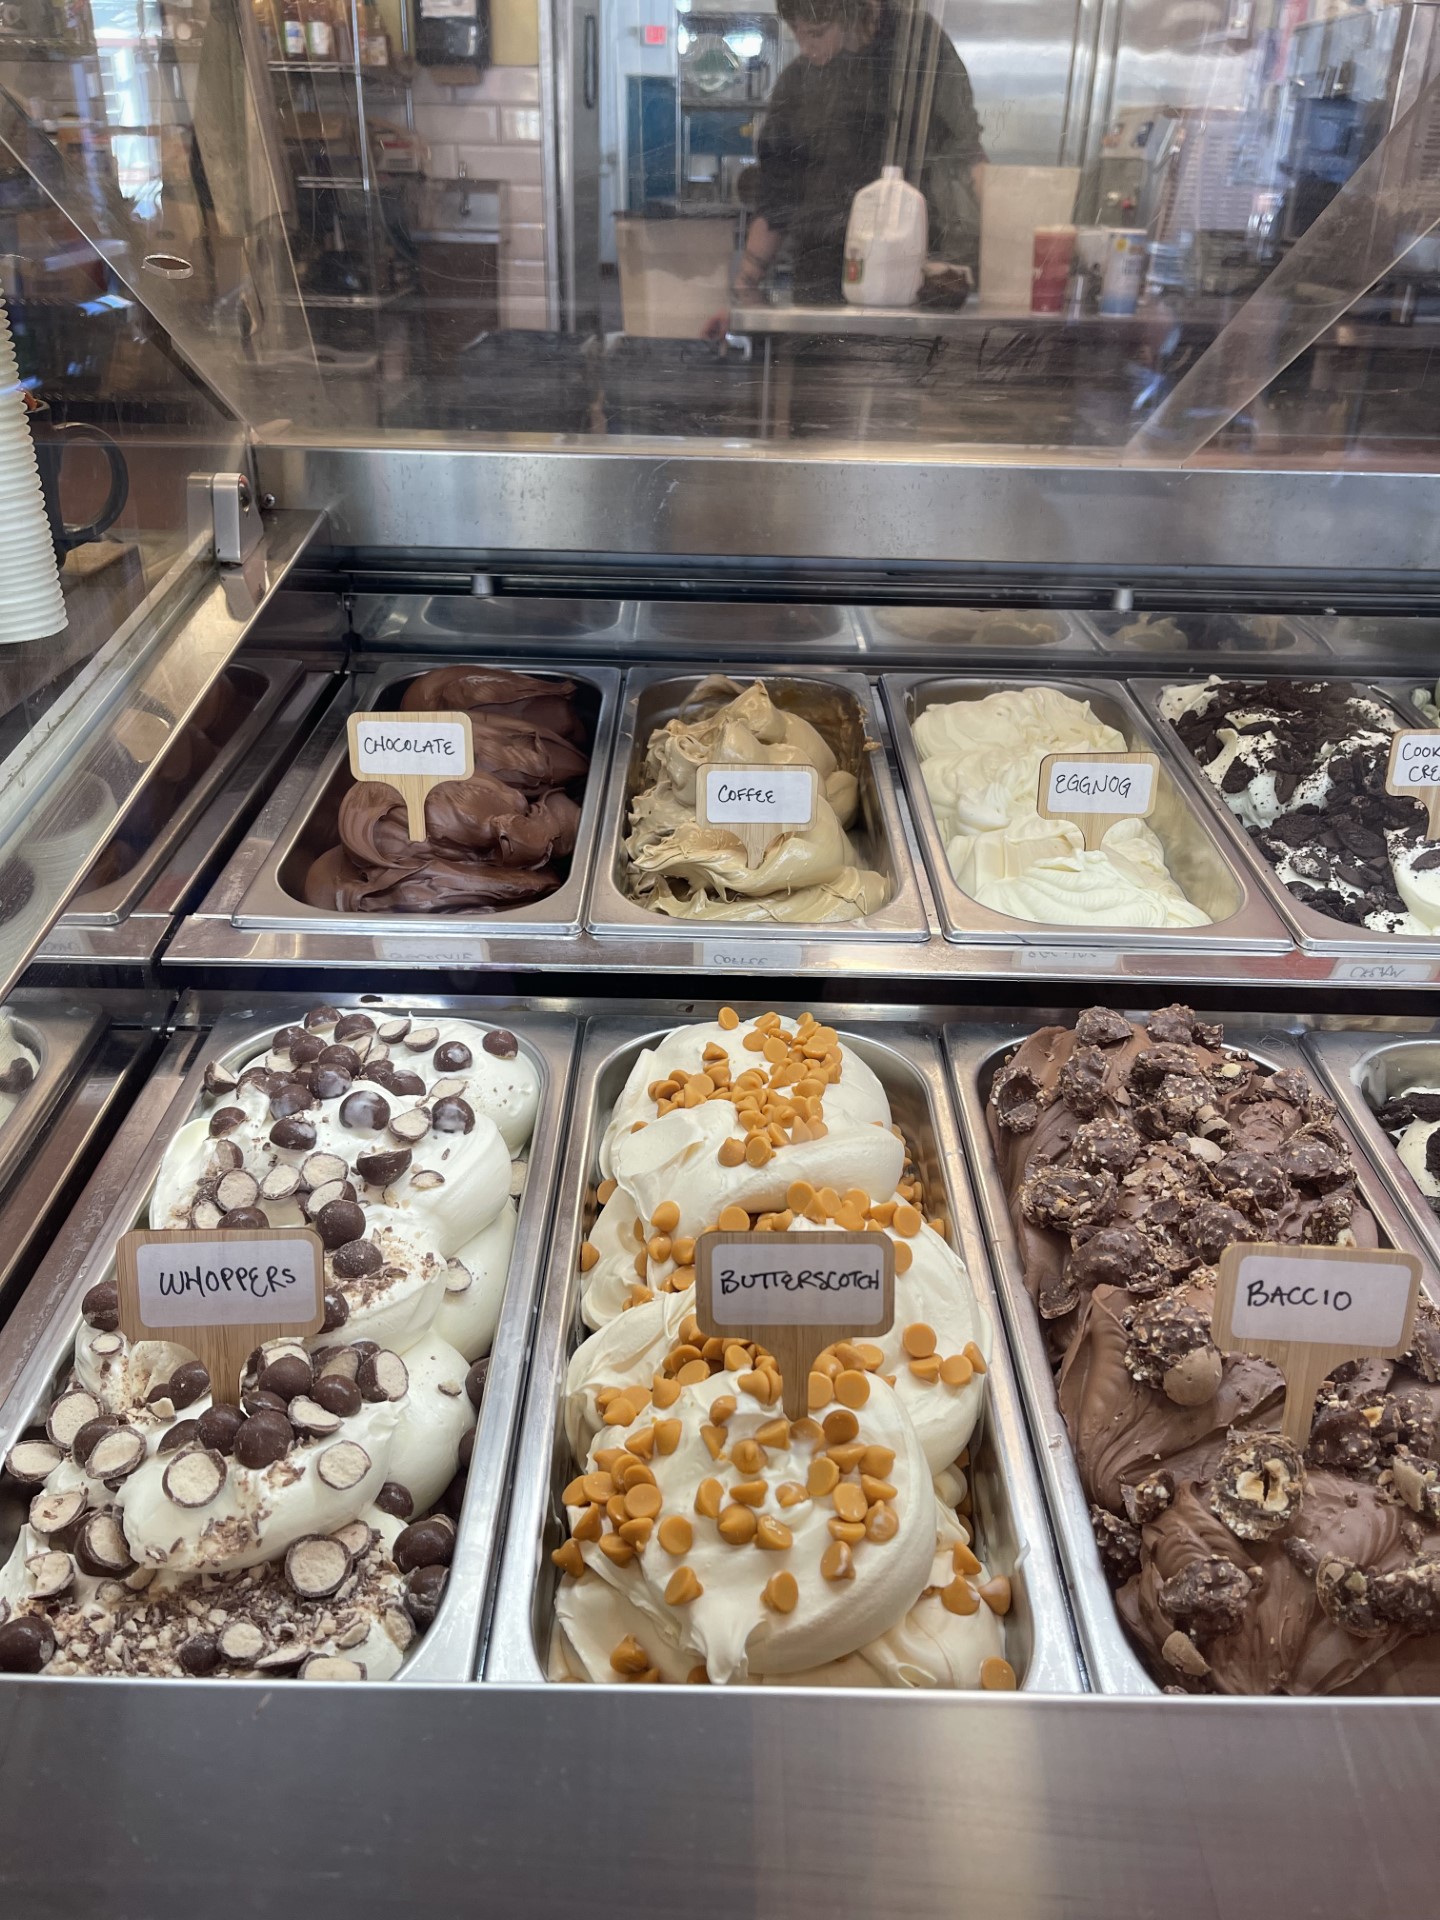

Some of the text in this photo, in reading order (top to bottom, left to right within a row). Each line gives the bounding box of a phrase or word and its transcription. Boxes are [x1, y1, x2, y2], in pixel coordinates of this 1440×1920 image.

[362, 735, 456, 756] CHOCOLATE
[1055, 773, 1132, 799] EGGNOG
[1408, 764, 1440, 783] CRE
[717, 783, 776, 805] COFFEE
[158, 1264, 298, 1298] WHOPPERS
[719, 1268, 881, 1296] BUTTERSCOTCH
[1246, 1279, 1353, 1312] BACCIO
